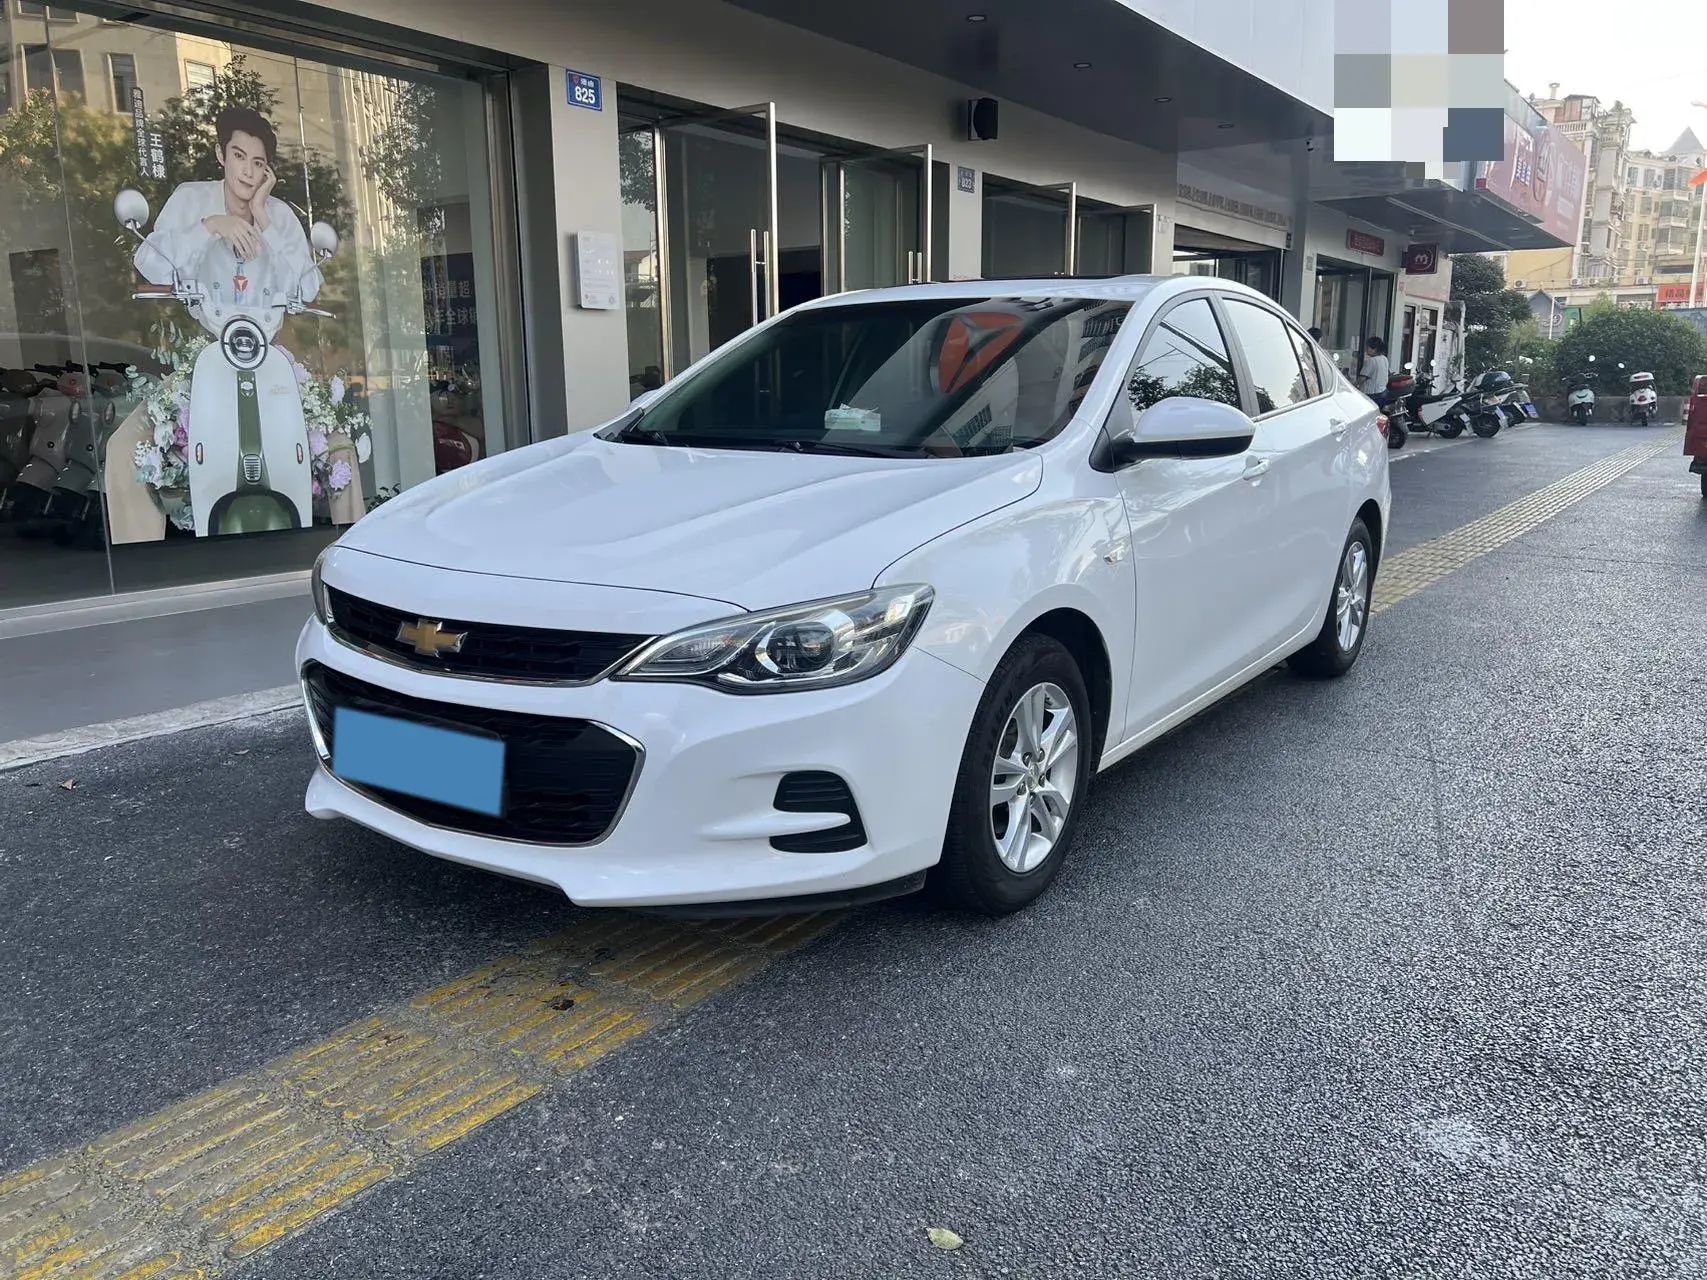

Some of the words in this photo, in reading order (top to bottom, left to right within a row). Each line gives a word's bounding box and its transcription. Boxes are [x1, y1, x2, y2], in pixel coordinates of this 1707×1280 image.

[575, 86, 596, 104] 825
[150, 133, 166, 178] 王鹤棣
